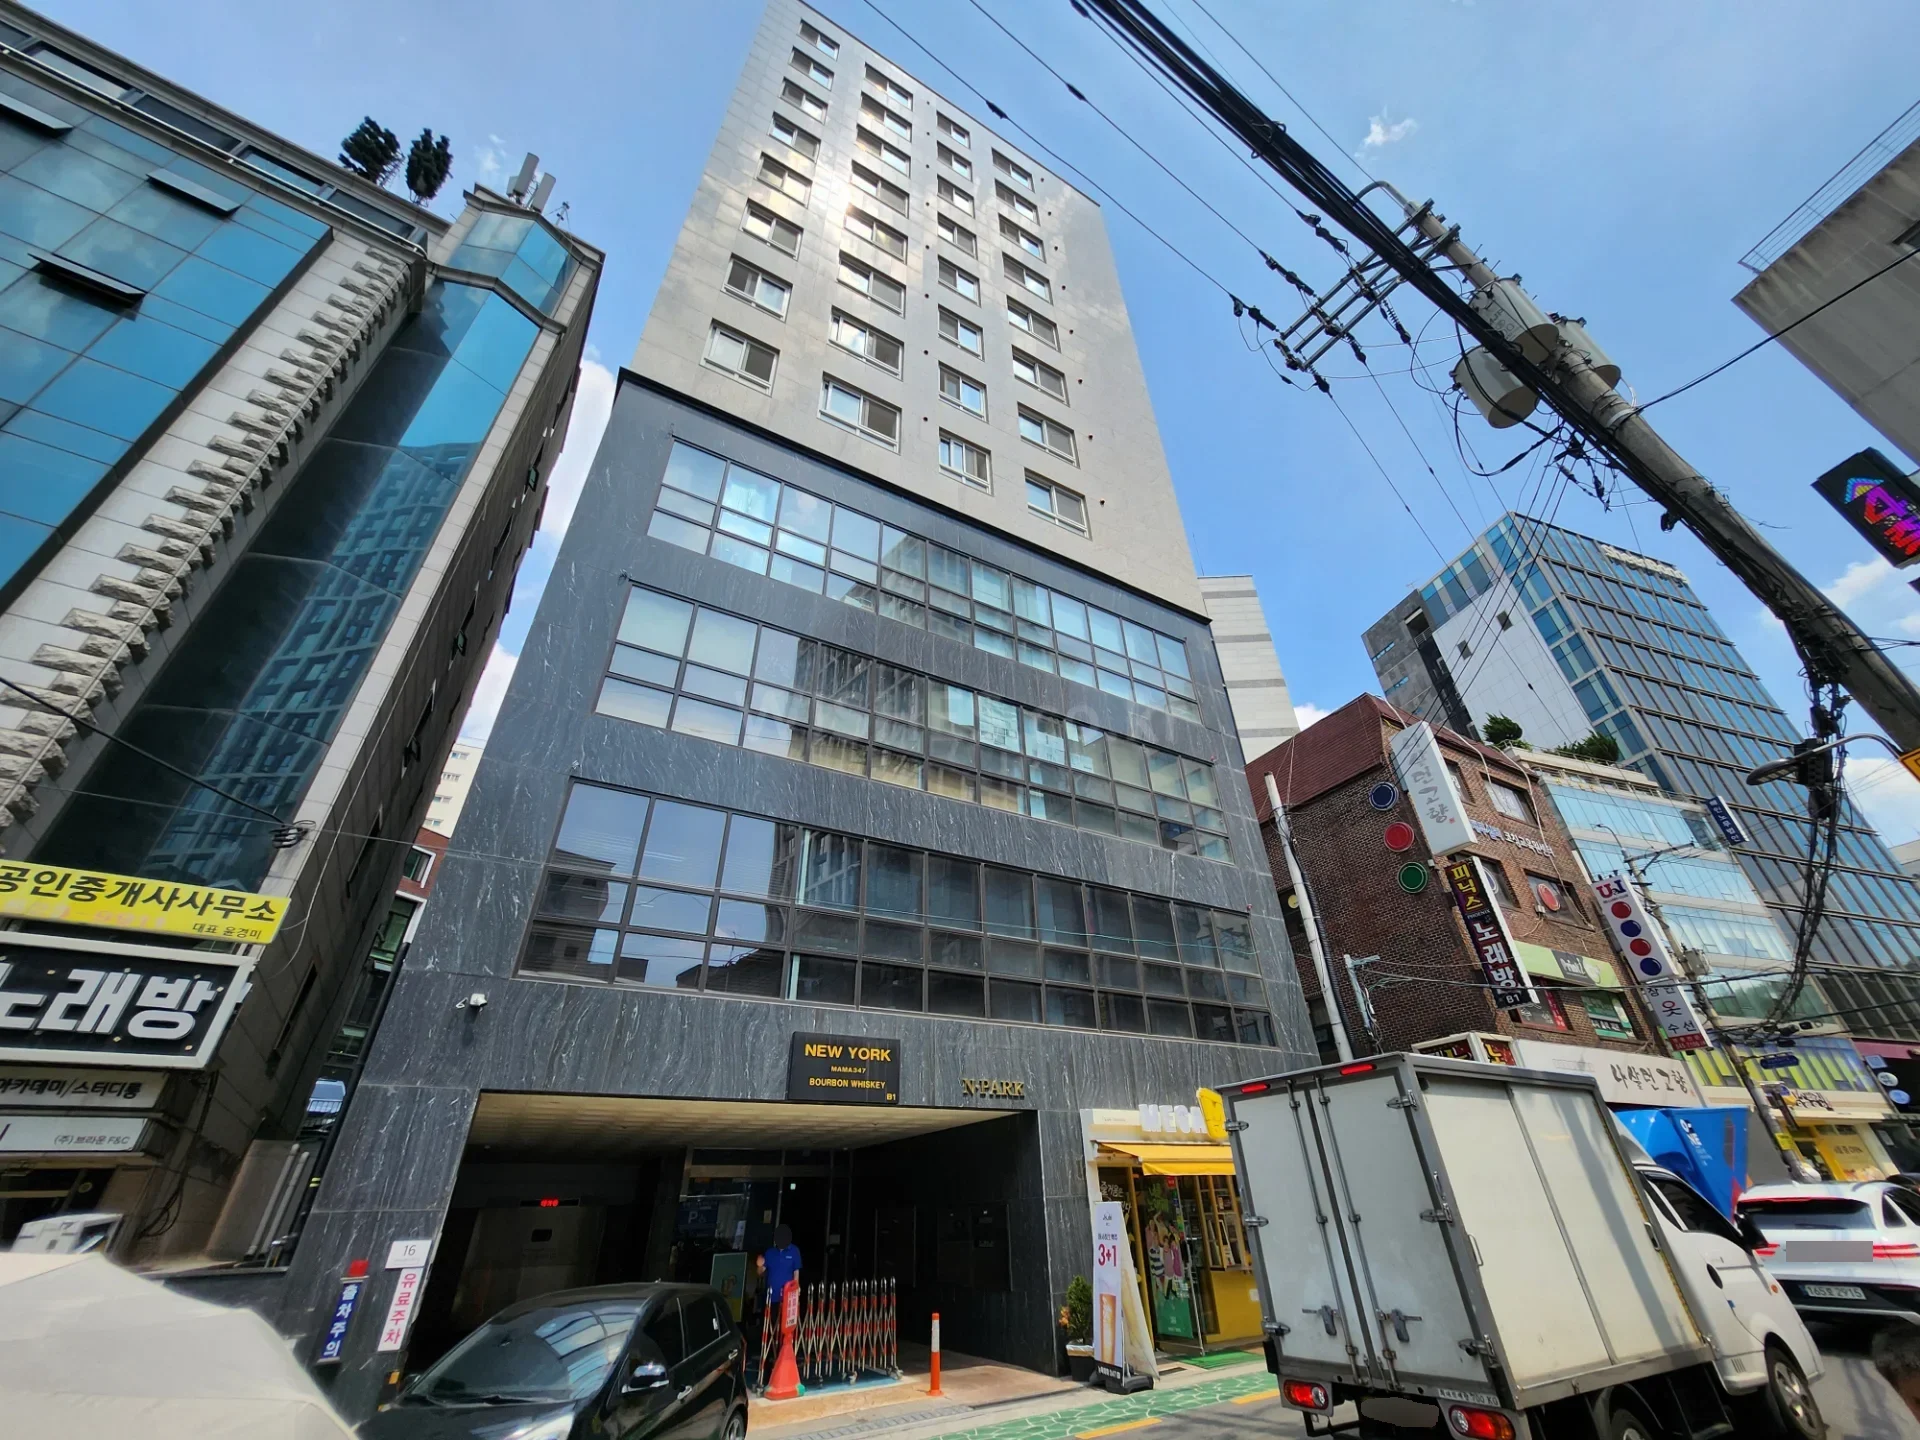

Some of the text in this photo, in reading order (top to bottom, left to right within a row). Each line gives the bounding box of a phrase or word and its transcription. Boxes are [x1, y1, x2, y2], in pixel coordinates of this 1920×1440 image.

[0, 866, 277, 922] 공인중개사사무소
[1451, 864, 1483, 911] 피닉스
[1466, 908, 1491, 919] PHOENIX
[192, 923, 262, 939] 대표 윤경미
[1473, 922, 1518, 991] 노래방
[1505, 994, 1520, 1004] B1
[1662, 1001, 1682, 1017] 옷
[1667, 1020, 1697, 1034] 수선
[804, 1043, 892, 1062] NEW YORK
[830, 1065, 867, 1075] MAMA347
[809, 1077, 886, 1090] BOURBON WHISKEY
[886, 1092, 897, 1101] B1
[54, 1135, 73, 1145] (주)
[107, 1136, 131, 1145] F&C
[688, 1211, 698, 1224] P
[403, 1244, 417, 1256] 16
[1098, 1243, 1117, 1267] 3+1
[384, 1273, 417, 1345] 유료주차
[323, 1284, 358, 1357] 출차주의
